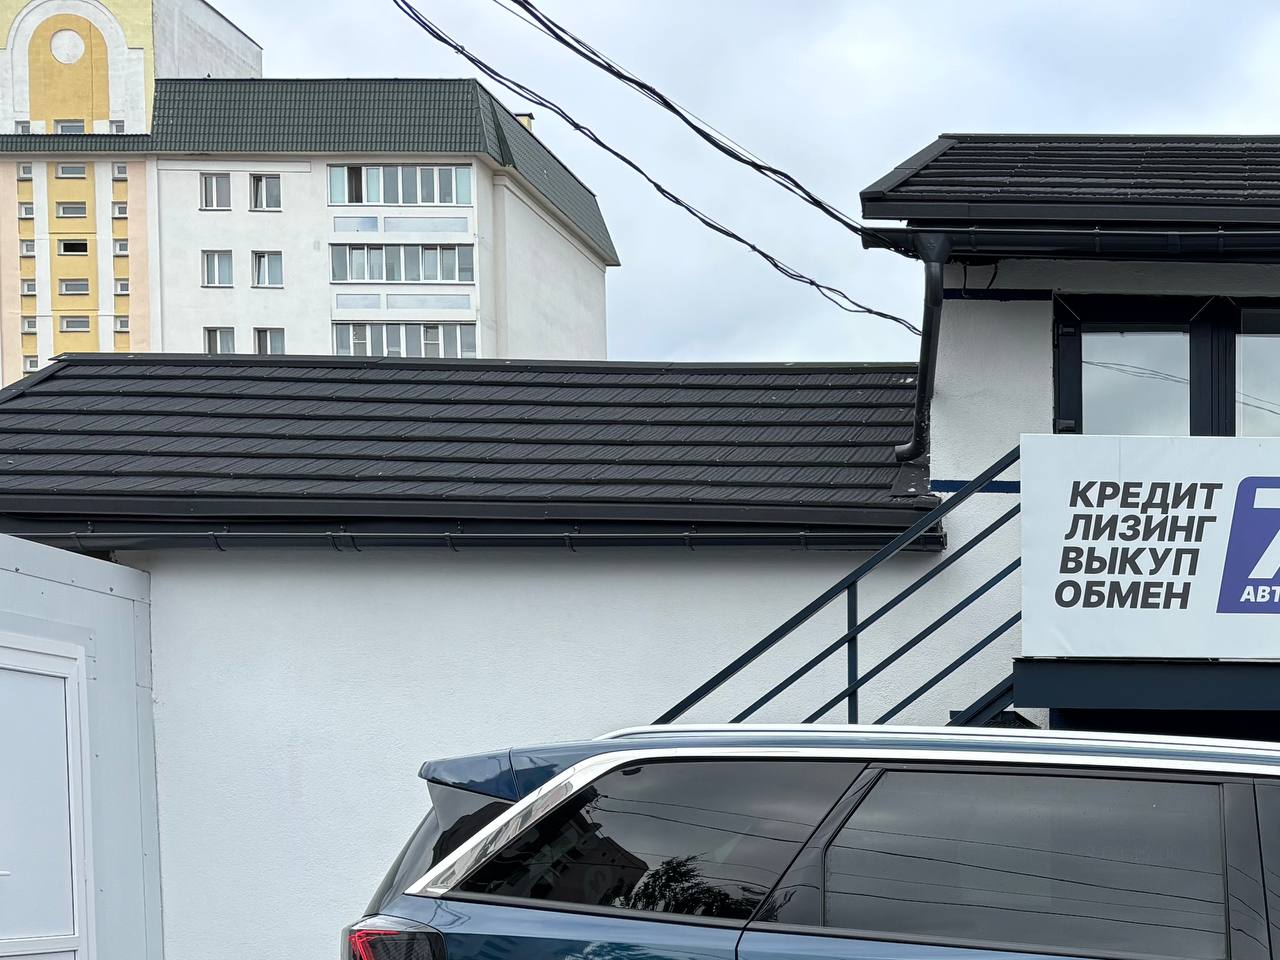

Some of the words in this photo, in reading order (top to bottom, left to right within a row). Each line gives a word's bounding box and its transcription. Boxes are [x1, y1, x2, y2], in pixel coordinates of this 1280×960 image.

[1069, 481, 1223, 514] КРЕДИТ
[1064, 514, 1217, 542] ЛИЗИНГ
[1059, 546, 1200, 576] ВЫКУП
[1055, 580, 1191, 609] ОБМЕН
